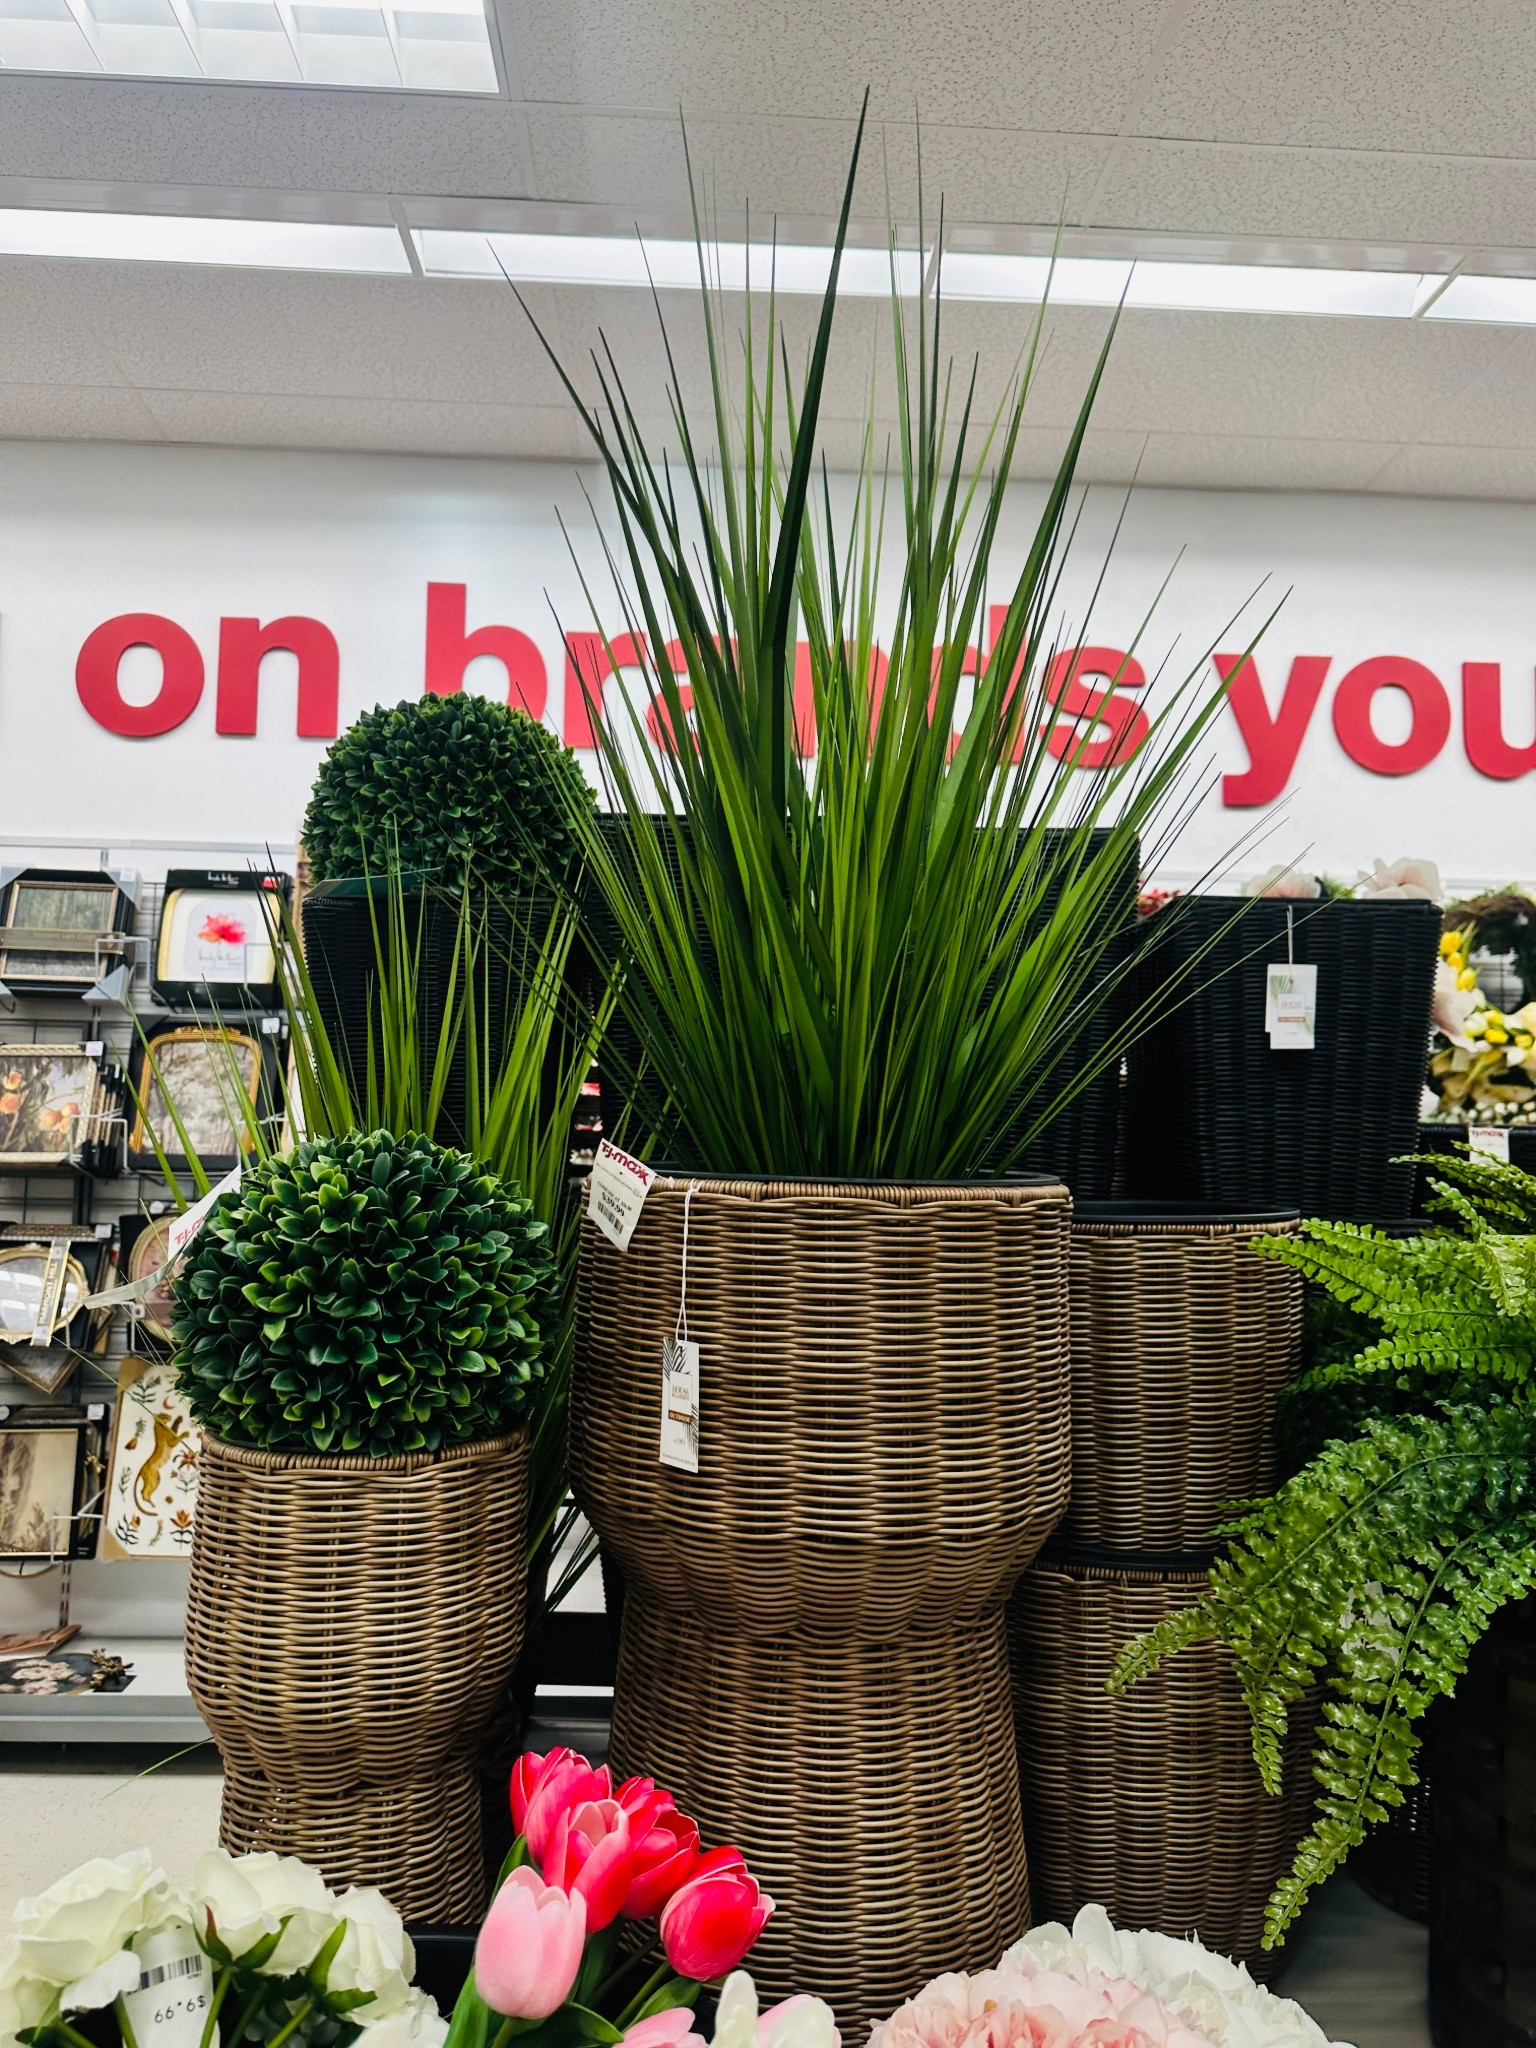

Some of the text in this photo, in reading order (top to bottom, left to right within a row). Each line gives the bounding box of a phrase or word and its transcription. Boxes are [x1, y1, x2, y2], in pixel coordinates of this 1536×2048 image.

[74, 612, 340, 739] on
[423, 581, 1150, 769] brs
[154, 1995, 206, 2024] $9.99
